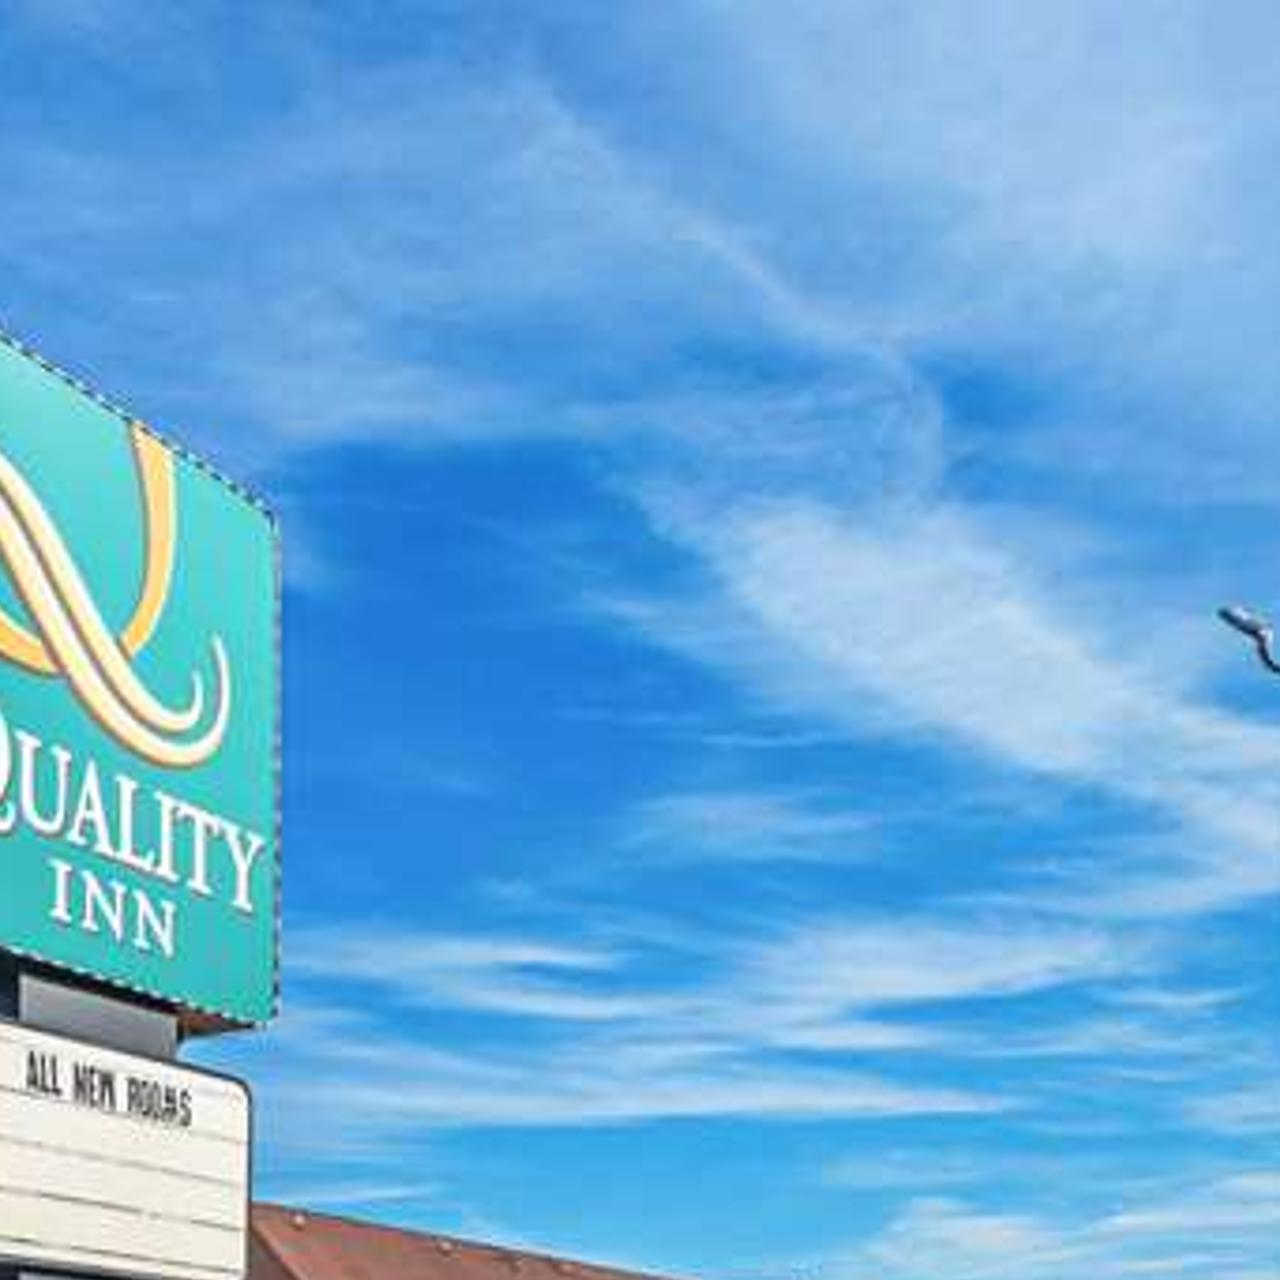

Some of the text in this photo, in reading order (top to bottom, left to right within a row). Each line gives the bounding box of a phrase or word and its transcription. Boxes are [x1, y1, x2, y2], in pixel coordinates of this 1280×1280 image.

[48, 859, 176, 957] INN
[26, 1050, 62, 1096] ALL
[126, 1076, 193, 1127] ROOMS
